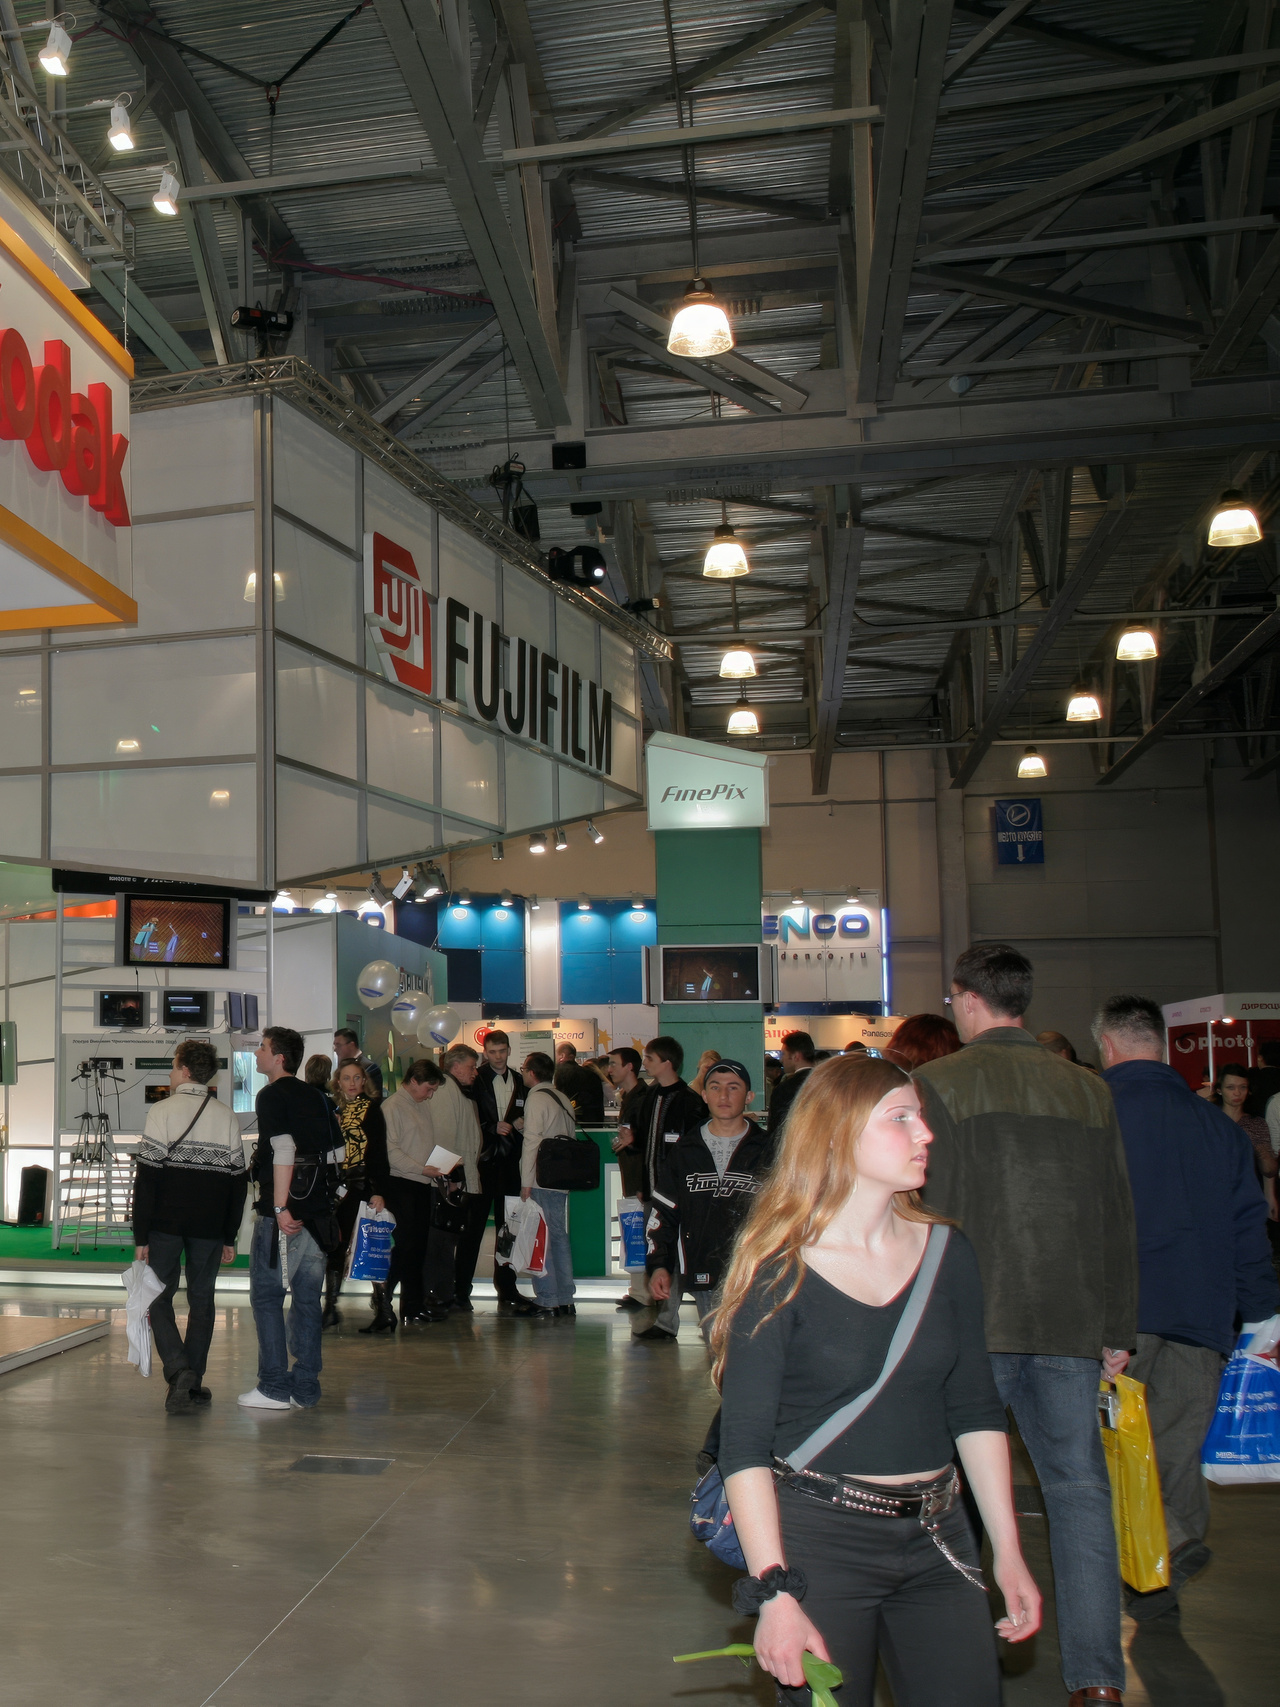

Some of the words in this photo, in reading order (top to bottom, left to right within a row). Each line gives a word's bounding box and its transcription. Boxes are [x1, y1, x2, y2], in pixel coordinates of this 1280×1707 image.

[439, 596, 612, 776] FUJIFILM
[660, 783, 749, 804] FinePix
[1198, 1034, 1255, 1051] photo
